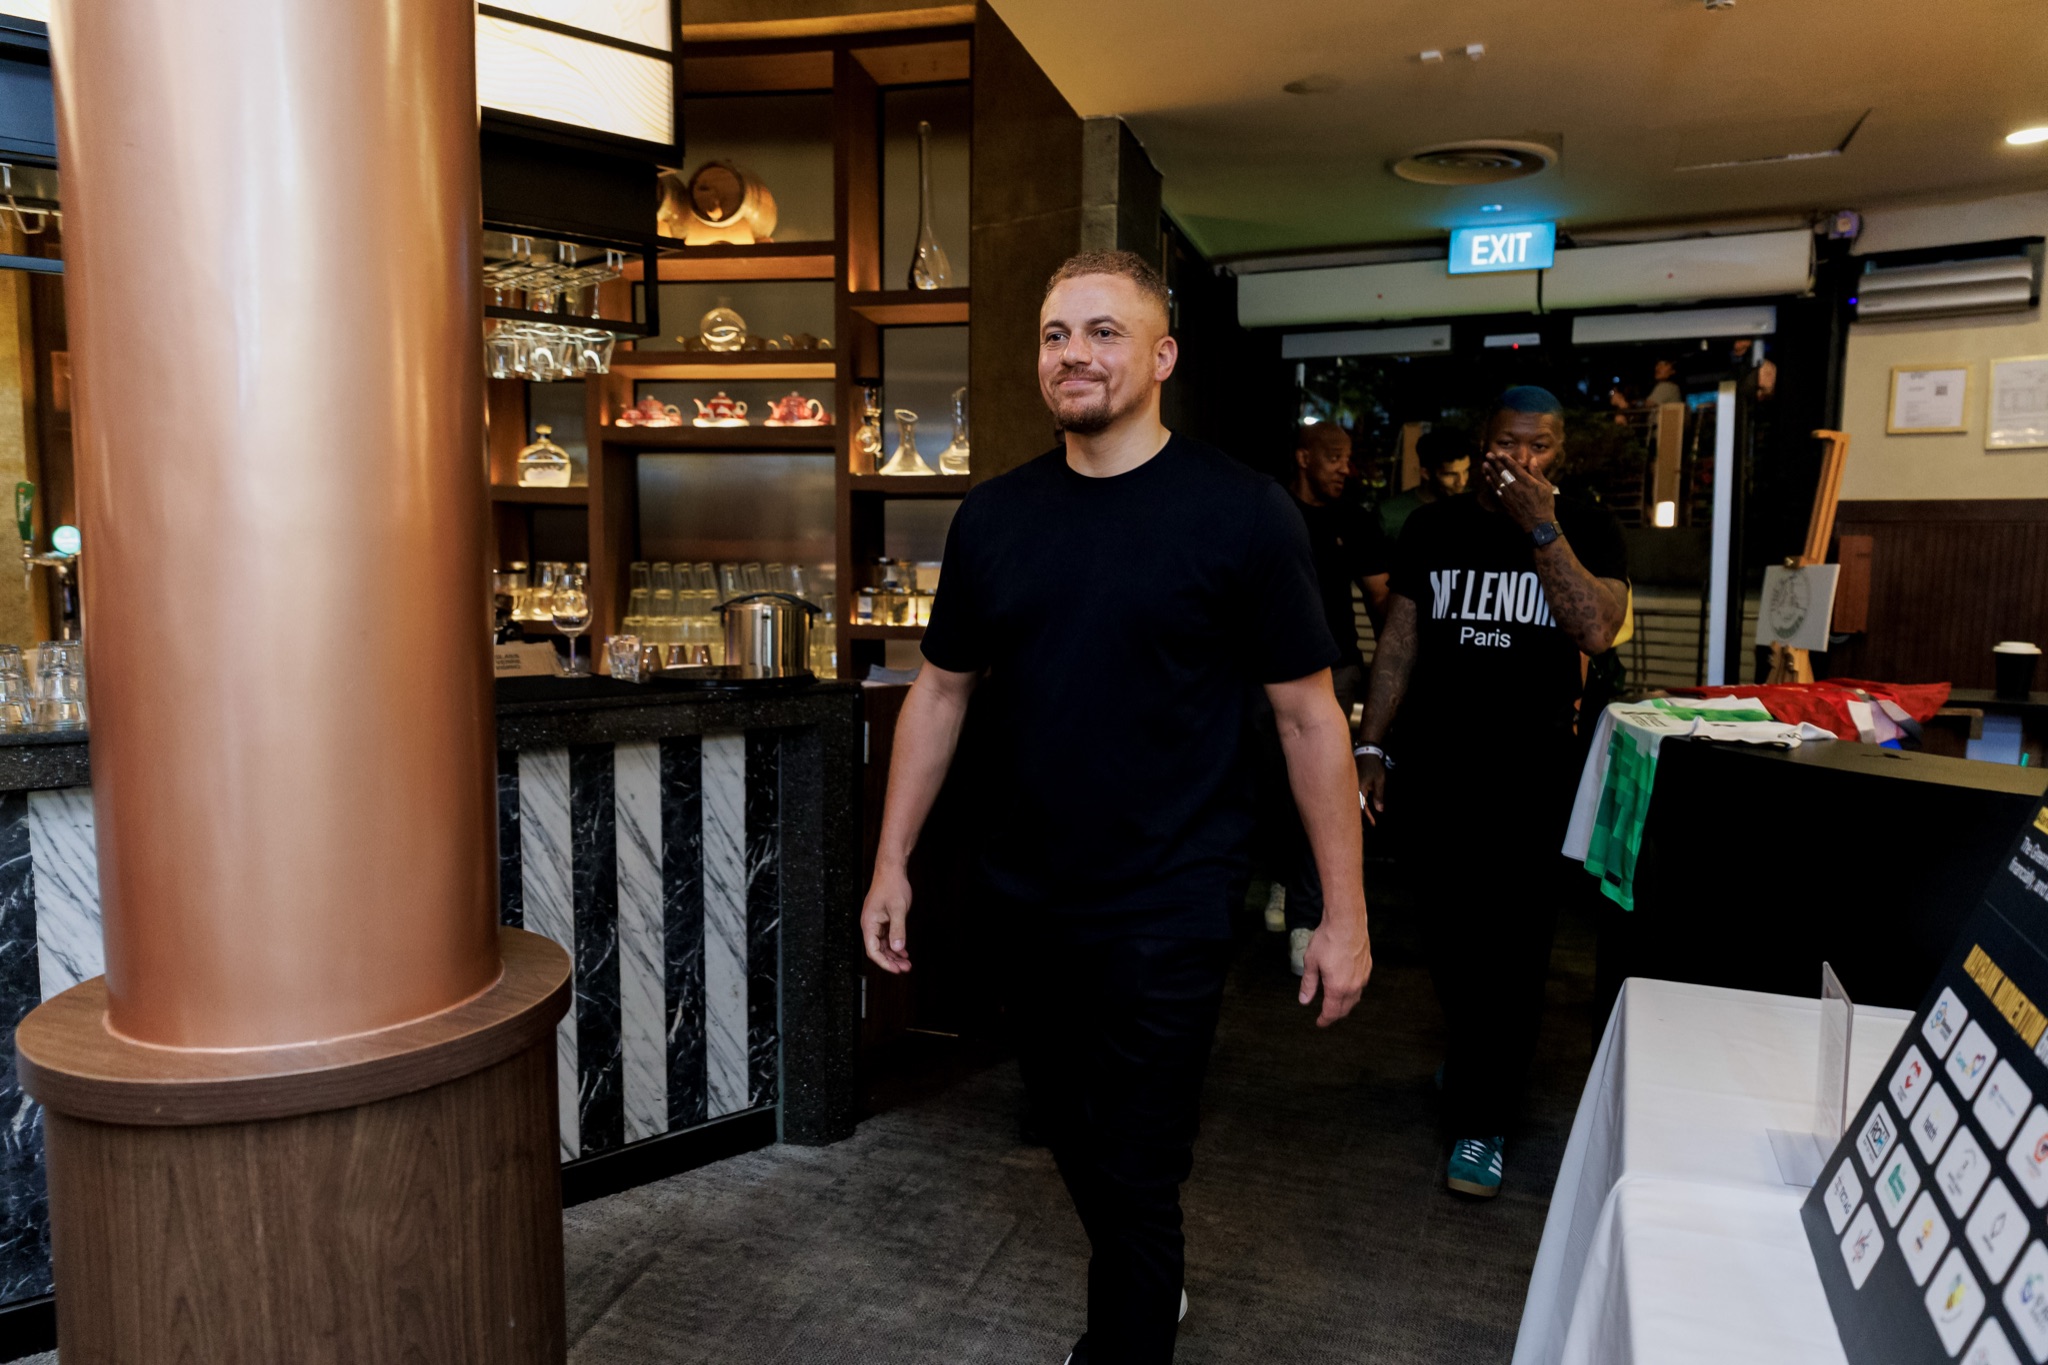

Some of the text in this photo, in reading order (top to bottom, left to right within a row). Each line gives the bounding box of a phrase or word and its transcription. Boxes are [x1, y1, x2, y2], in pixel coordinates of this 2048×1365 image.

[1471, 232, 1532, 265] EXIT
[1461, 570, 1556, 627] LENOI
[1460, 627, 1511, 648] Paris
